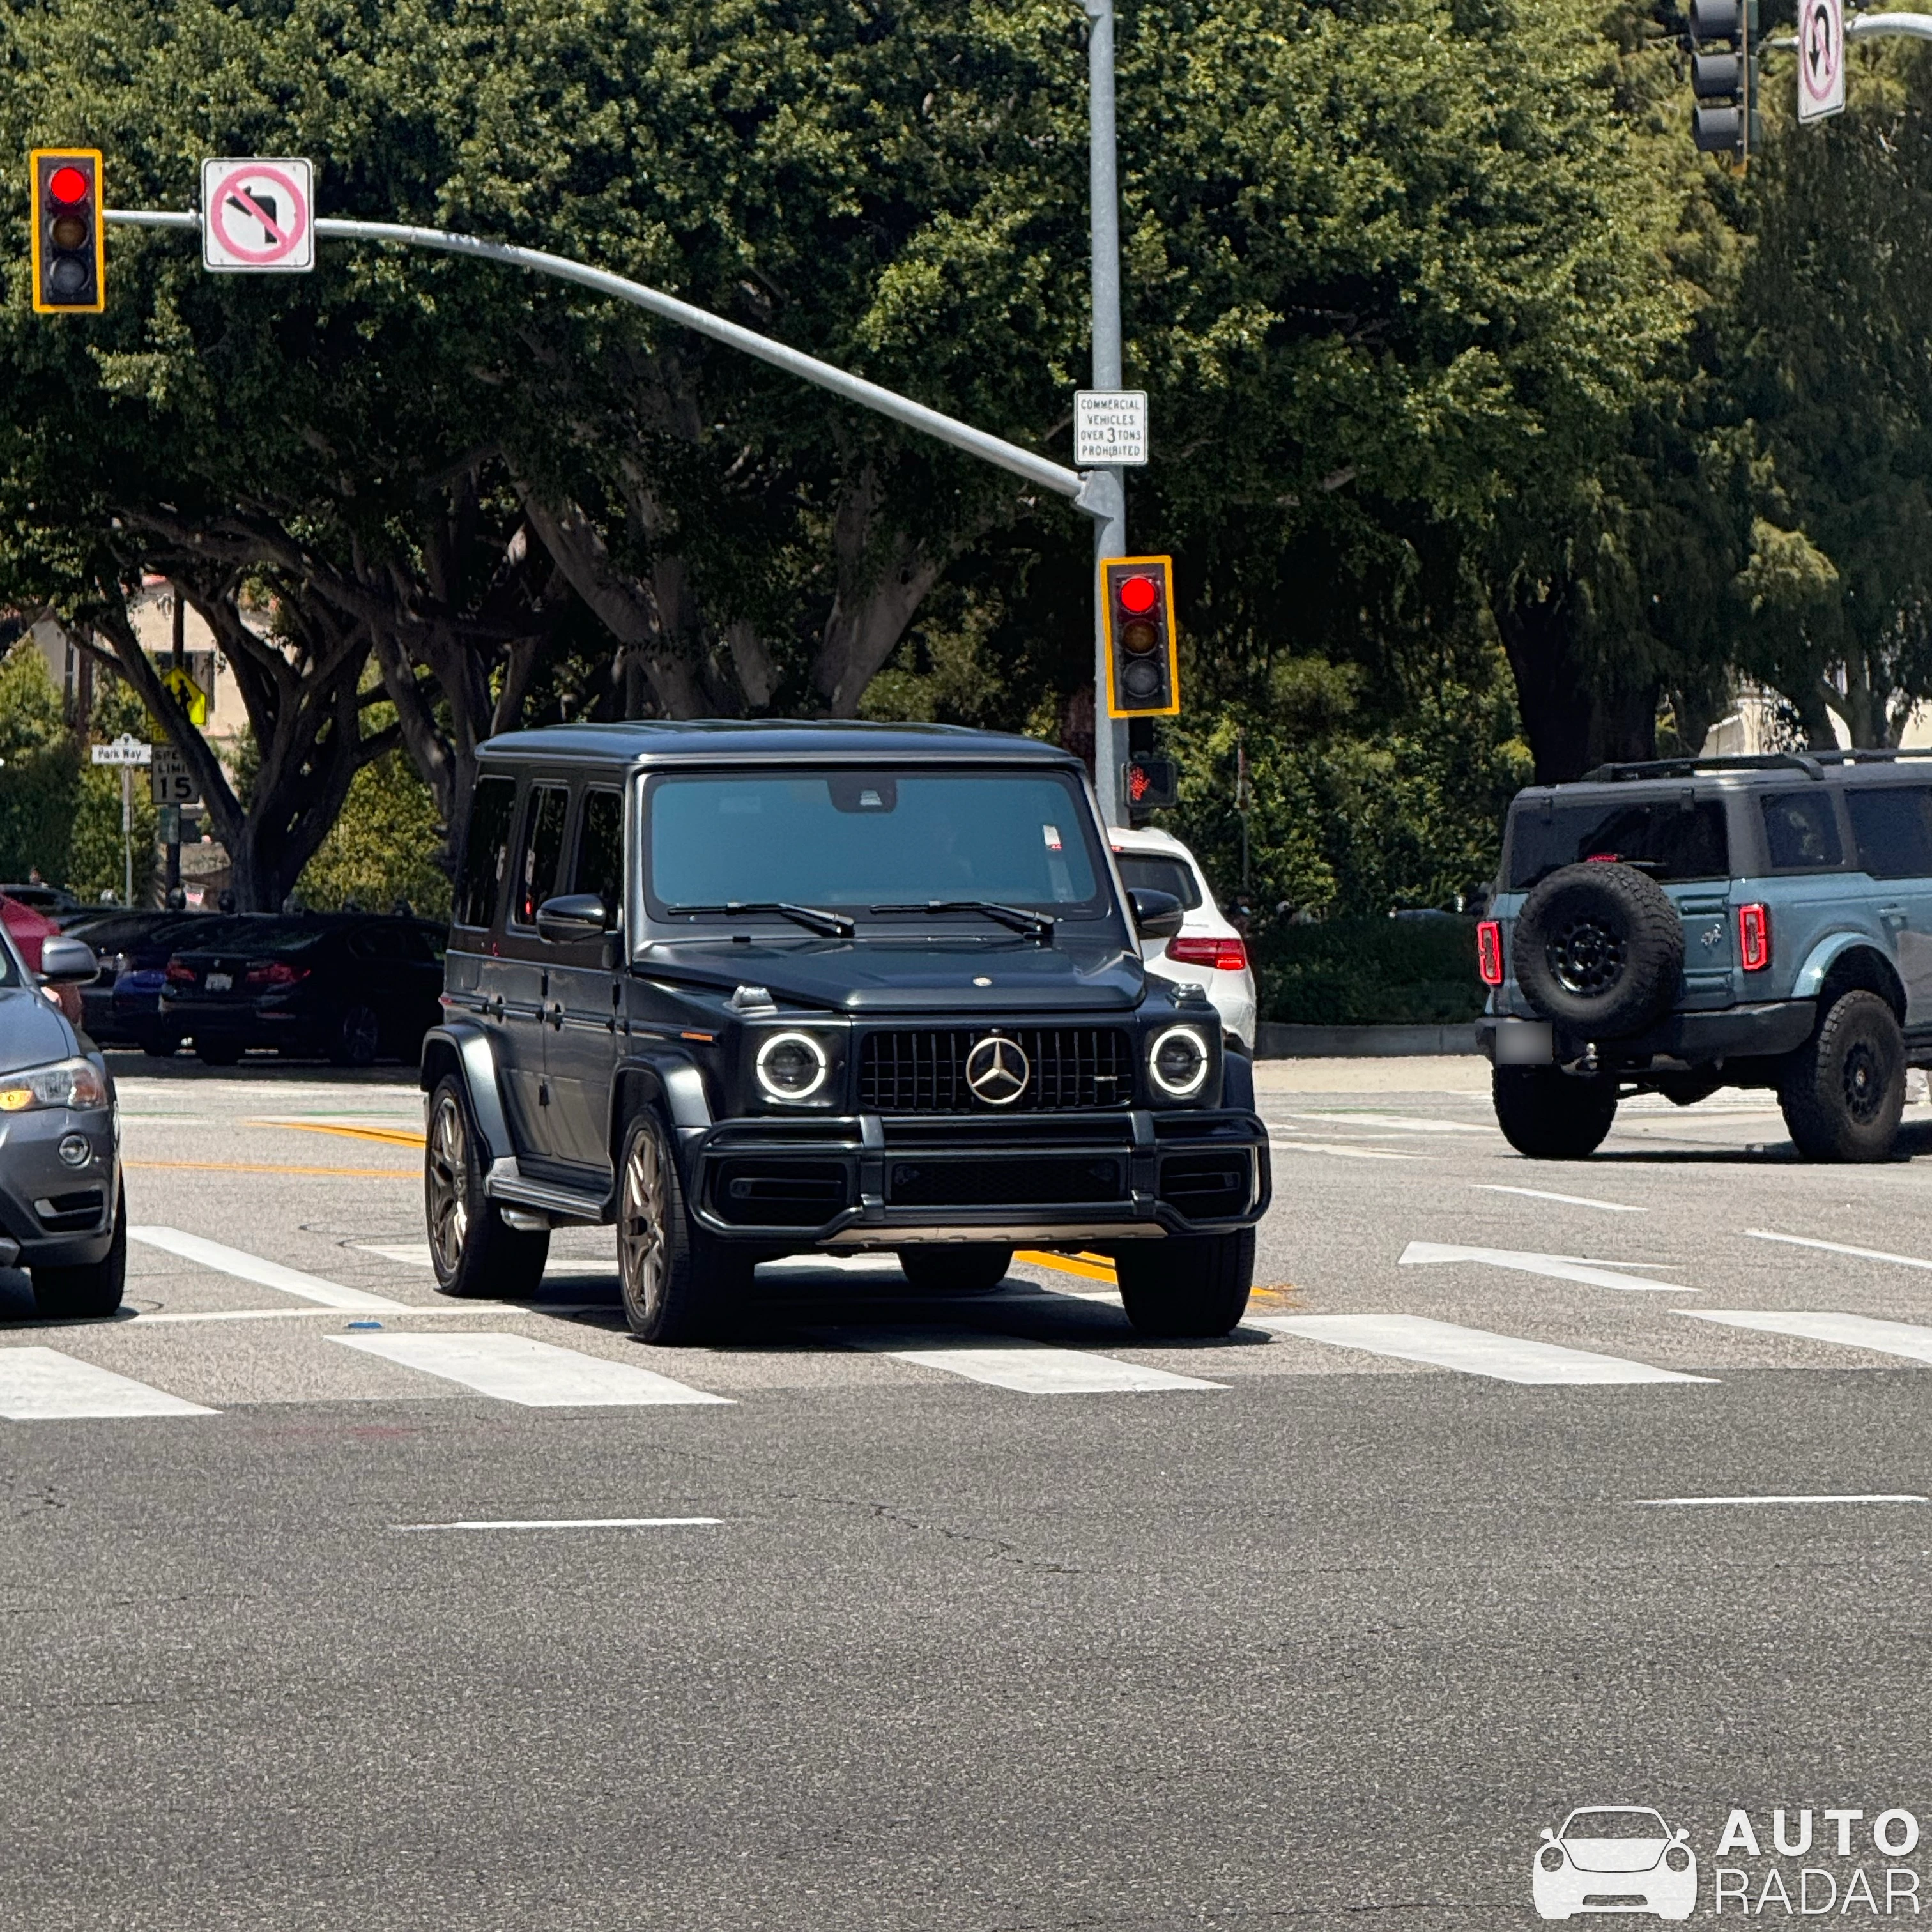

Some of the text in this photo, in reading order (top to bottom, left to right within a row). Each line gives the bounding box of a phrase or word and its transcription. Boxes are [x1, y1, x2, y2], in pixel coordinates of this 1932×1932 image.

[1081, 399, 1140, 410] COMMERCIAL
[1087, 415, 1135, 425] VEHICLES
[1080, 427, 1141, 443] OVER 3 TONS
[1082, 445, 1140, 456] PROHIBITED
[98, 747, 141, 760] Park Way
[154, 749, 181, 760] SPE
[158, 762, 187, 773] LIMI
[160, 776, 192, 798] 15
